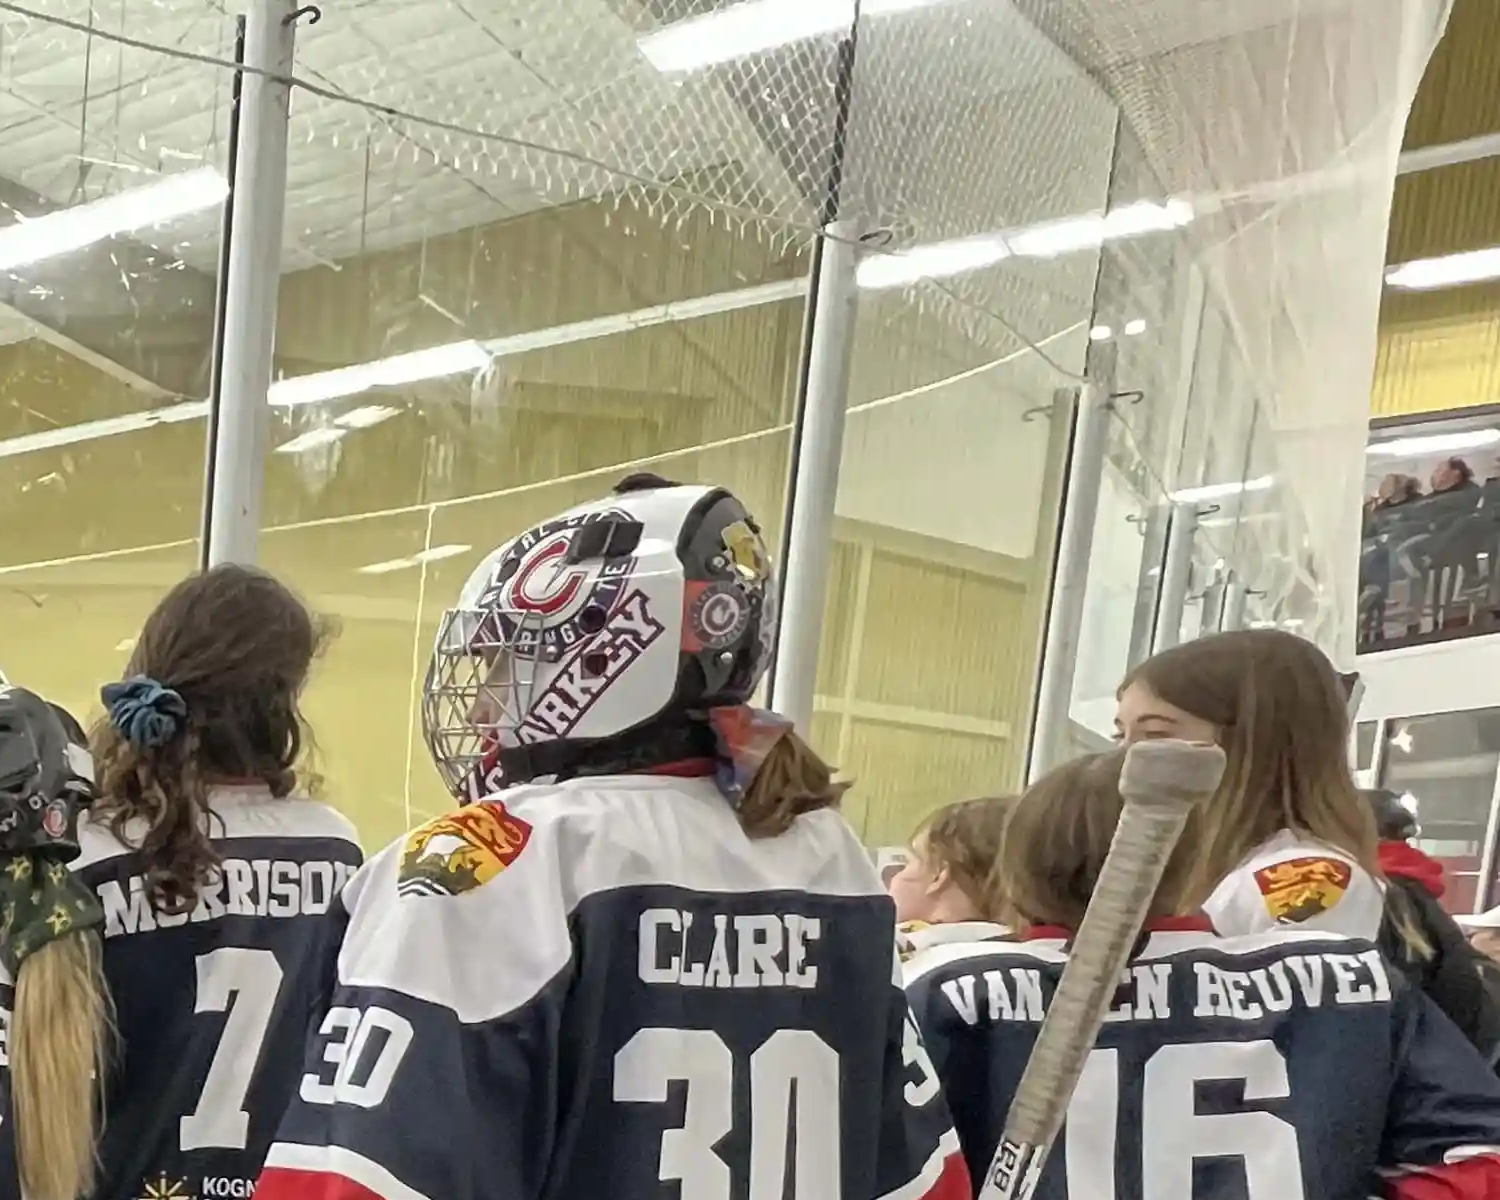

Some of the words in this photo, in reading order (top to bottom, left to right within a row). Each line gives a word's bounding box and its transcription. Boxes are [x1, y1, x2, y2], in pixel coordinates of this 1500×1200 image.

[638, 907, 821, 989] CLARE
[941, 968, 1045, 1025] VAN
[1103, 962, 1170, 1023] EN
[179, 946, 284, 1151] 7
[299, 1006, 414, 1109] 30
